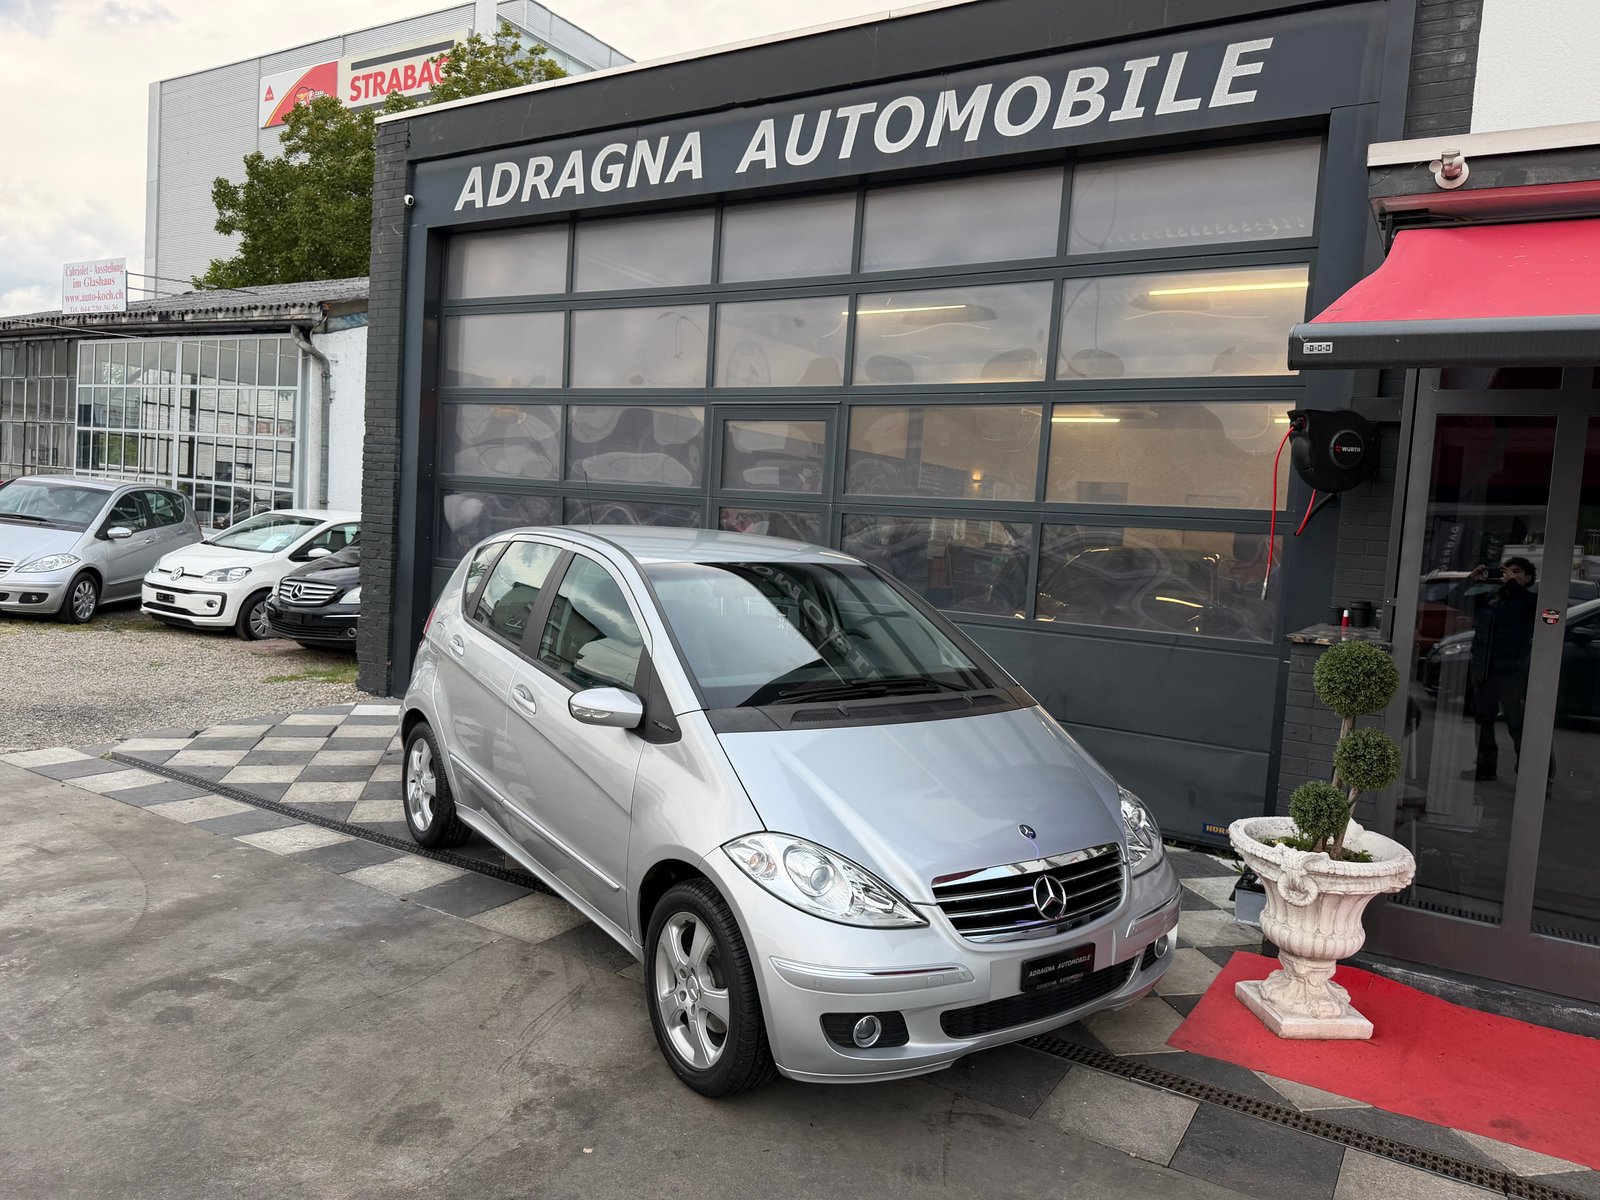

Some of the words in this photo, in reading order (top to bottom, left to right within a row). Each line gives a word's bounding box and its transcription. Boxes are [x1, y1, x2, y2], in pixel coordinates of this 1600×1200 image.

[454, 131, 703, 212] ADRAGNA
[735, 37, 1275, 174] AUTOMOBILE
[73, 278, 81, 288] im
[83, 276, 116, 287] Glashaus
[65, 290, 124, 302] www.auto-koch.ch
